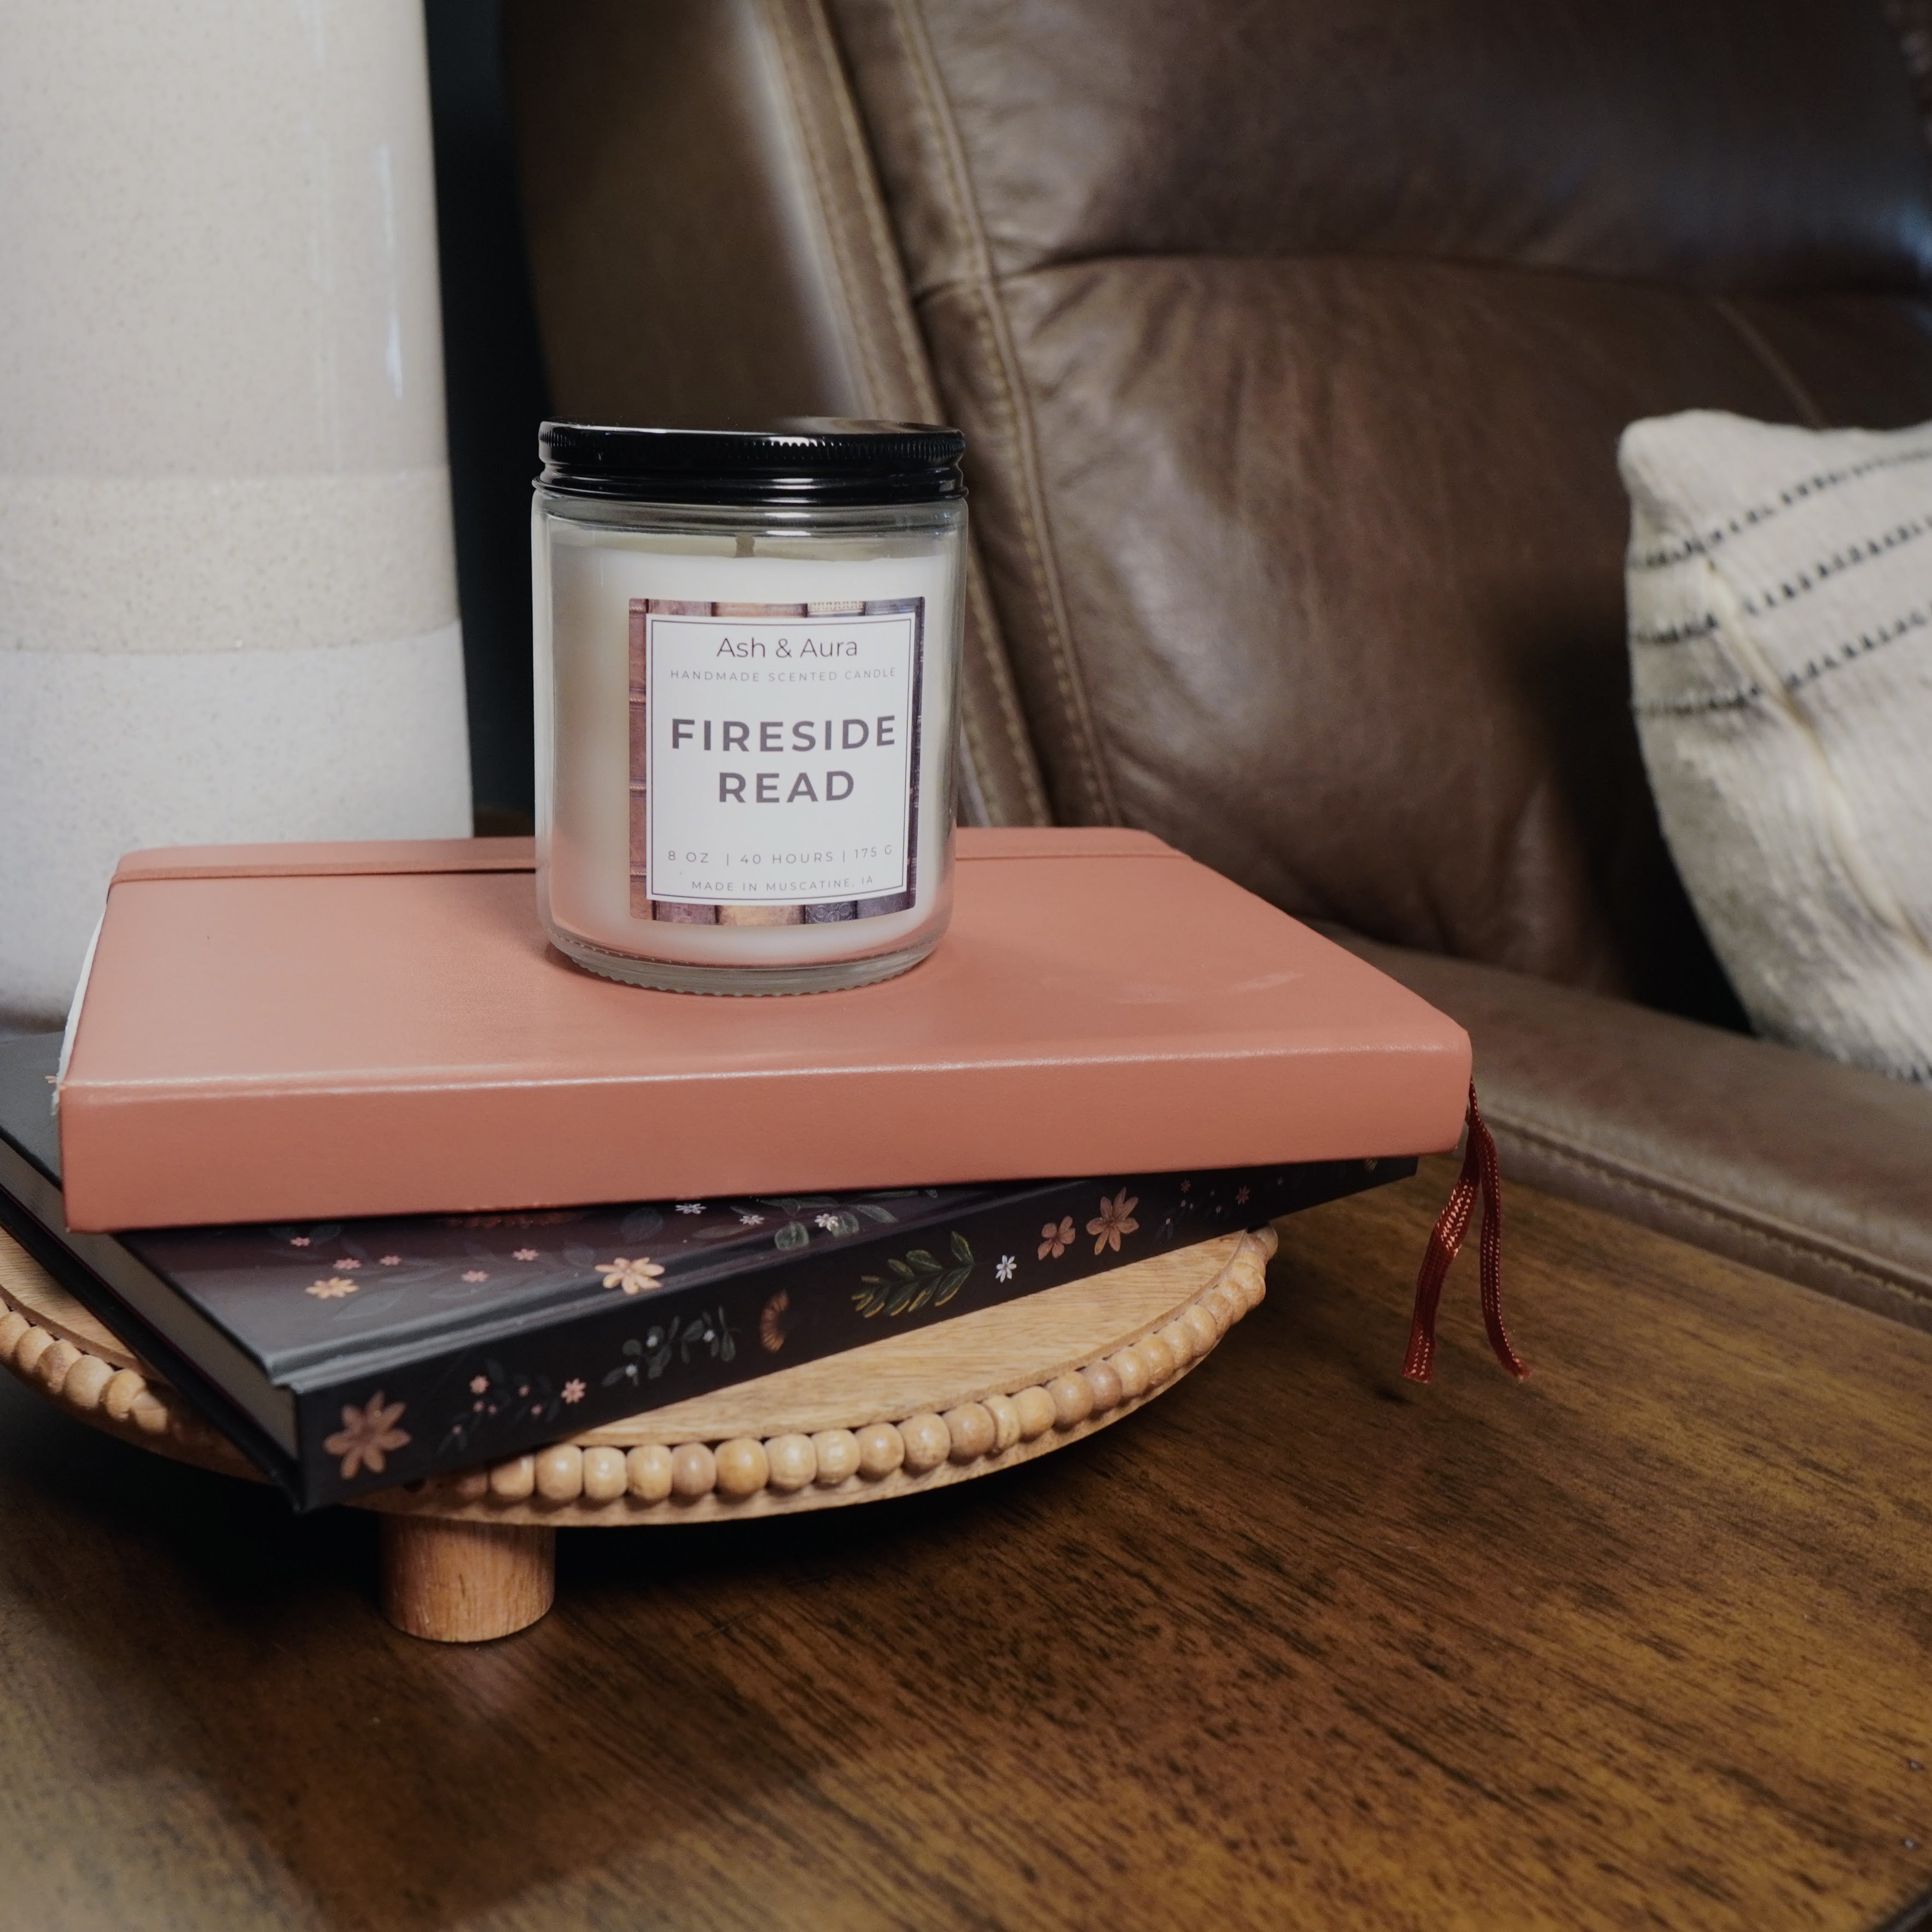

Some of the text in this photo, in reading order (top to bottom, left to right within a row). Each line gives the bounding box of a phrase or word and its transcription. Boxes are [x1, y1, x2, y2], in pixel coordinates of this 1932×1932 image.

[716, 637, 858, 658] Ash & Aura
[671, 667, 895, 682] HANDMADE SCENTED CANDLE
[672, 715, 895, 752] FIRESIDE
[719, 770, 854, 804] READ
[668, 850, 676, 861] 8
[685, 852, 709, 864] OZ
[740, 854, 761, 865] 40
[772, 851, 833, 864] HOURS
[854, 847, 877, 859] 175
[884, 845, 892, 855] G
[691, 881, 734, 892] MADE
[742, 882, 758, 892] IN
[862, 876, 874, 885] IA
